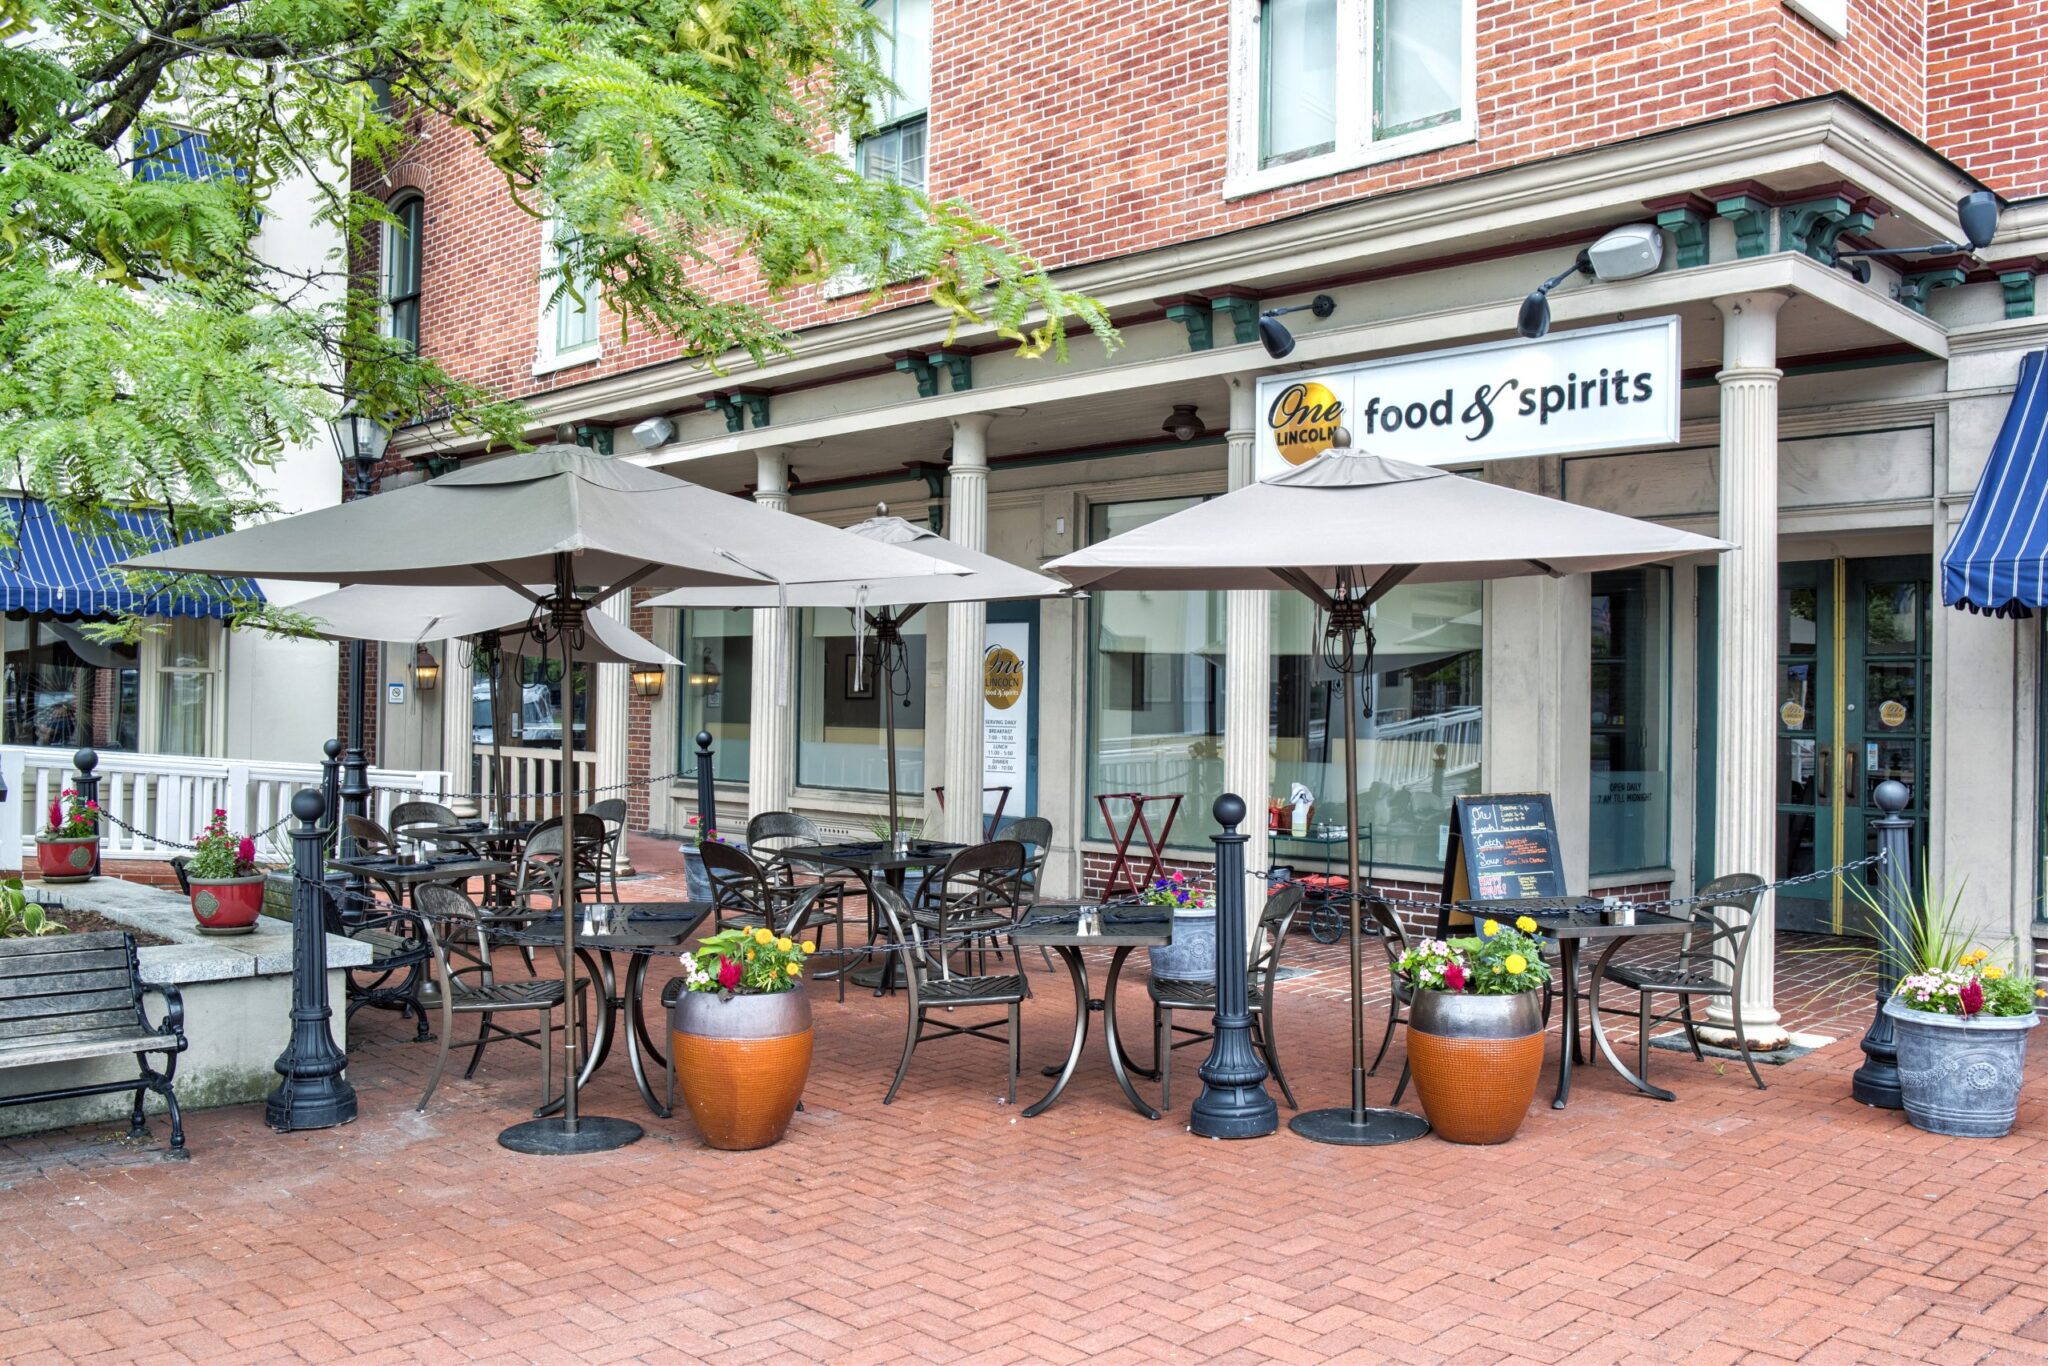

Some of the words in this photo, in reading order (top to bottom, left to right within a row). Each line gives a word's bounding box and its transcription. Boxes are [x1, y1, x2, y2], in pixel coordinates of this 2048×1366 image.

[1268, 382, 1344, 430] One
[1364, 388, 1453, 434] food
[1461, 378, 1519, 441] &
[1518, 368, 1653, 424] spirits
[1276, 425, 1338, 446] LINCOLN
[984, 678, 1019, 688] LINCOLN
[1609, 782, 1625, 792] OPEN
[1626, 782, 1642, 792] DAILY
[1602, 795, 1612, 804] AM
[1614, 794, 1625, 803] TILL
[1626, 792, 1652, 802] MIDNIGHT
